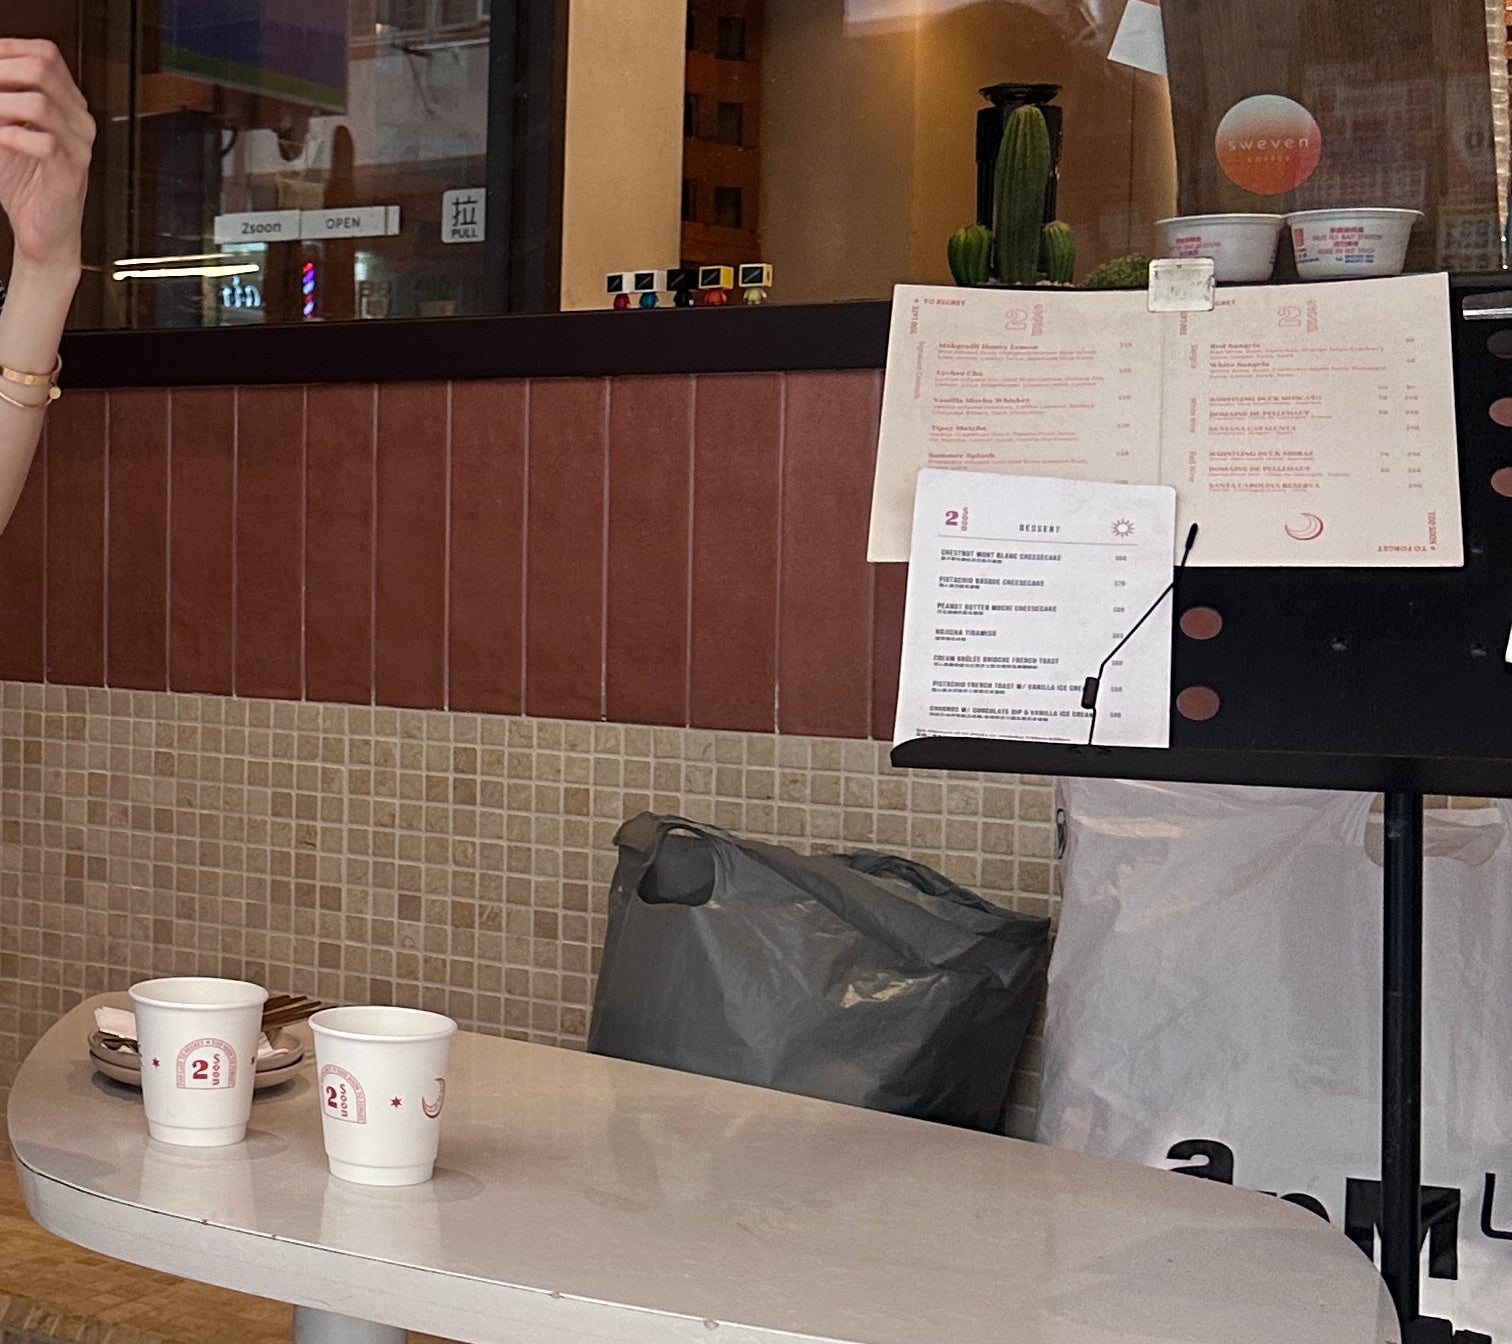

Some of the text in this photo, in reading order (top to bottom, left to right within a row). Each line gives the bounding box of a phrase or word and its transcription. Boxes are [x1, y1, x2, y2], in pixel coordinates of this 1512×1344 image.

[1228, 137, 1309, 151] sweven
[452, 195, 478, 227] 拉
[242, 217, 361, 234] 2soon OPEN
[451, 227, 478, 238] PULL
[1005, 308, 1028, 330] 2
[1277, 305, 1301, 327] 2
[945, 510, 959, 526] 2
[1019, 524, 1061, 534] DESSERT
[940, 549, 974, 557] CHESTNUT
[1019, 552, 1061, 561] CHEESECAKE
[939, 576, 1044, 587] PISTACHIO BASQUE CHEESECAKE
[937, 602, 962, 610] PEANUT
[964, 603, 989, 611] BUTTER
[1014, 605, 1057, 613] CHEESECAKE
[965, 629, 997, 637] TIRAMISU
[1012, 656, 1037, 664] FRENCH
[967, 681, 993, 689] FRENCH
[994, 682, 1015, 690] TOAST
[1027, 683, 1054, 691] VANILLA
[972, 707, 1009, 715] CHOCOLATE
[1030, 709, 1058, 717] VANILLA
[192, 1060, 208, 1079] 2
[326, 1086, 338, 1108] 2
